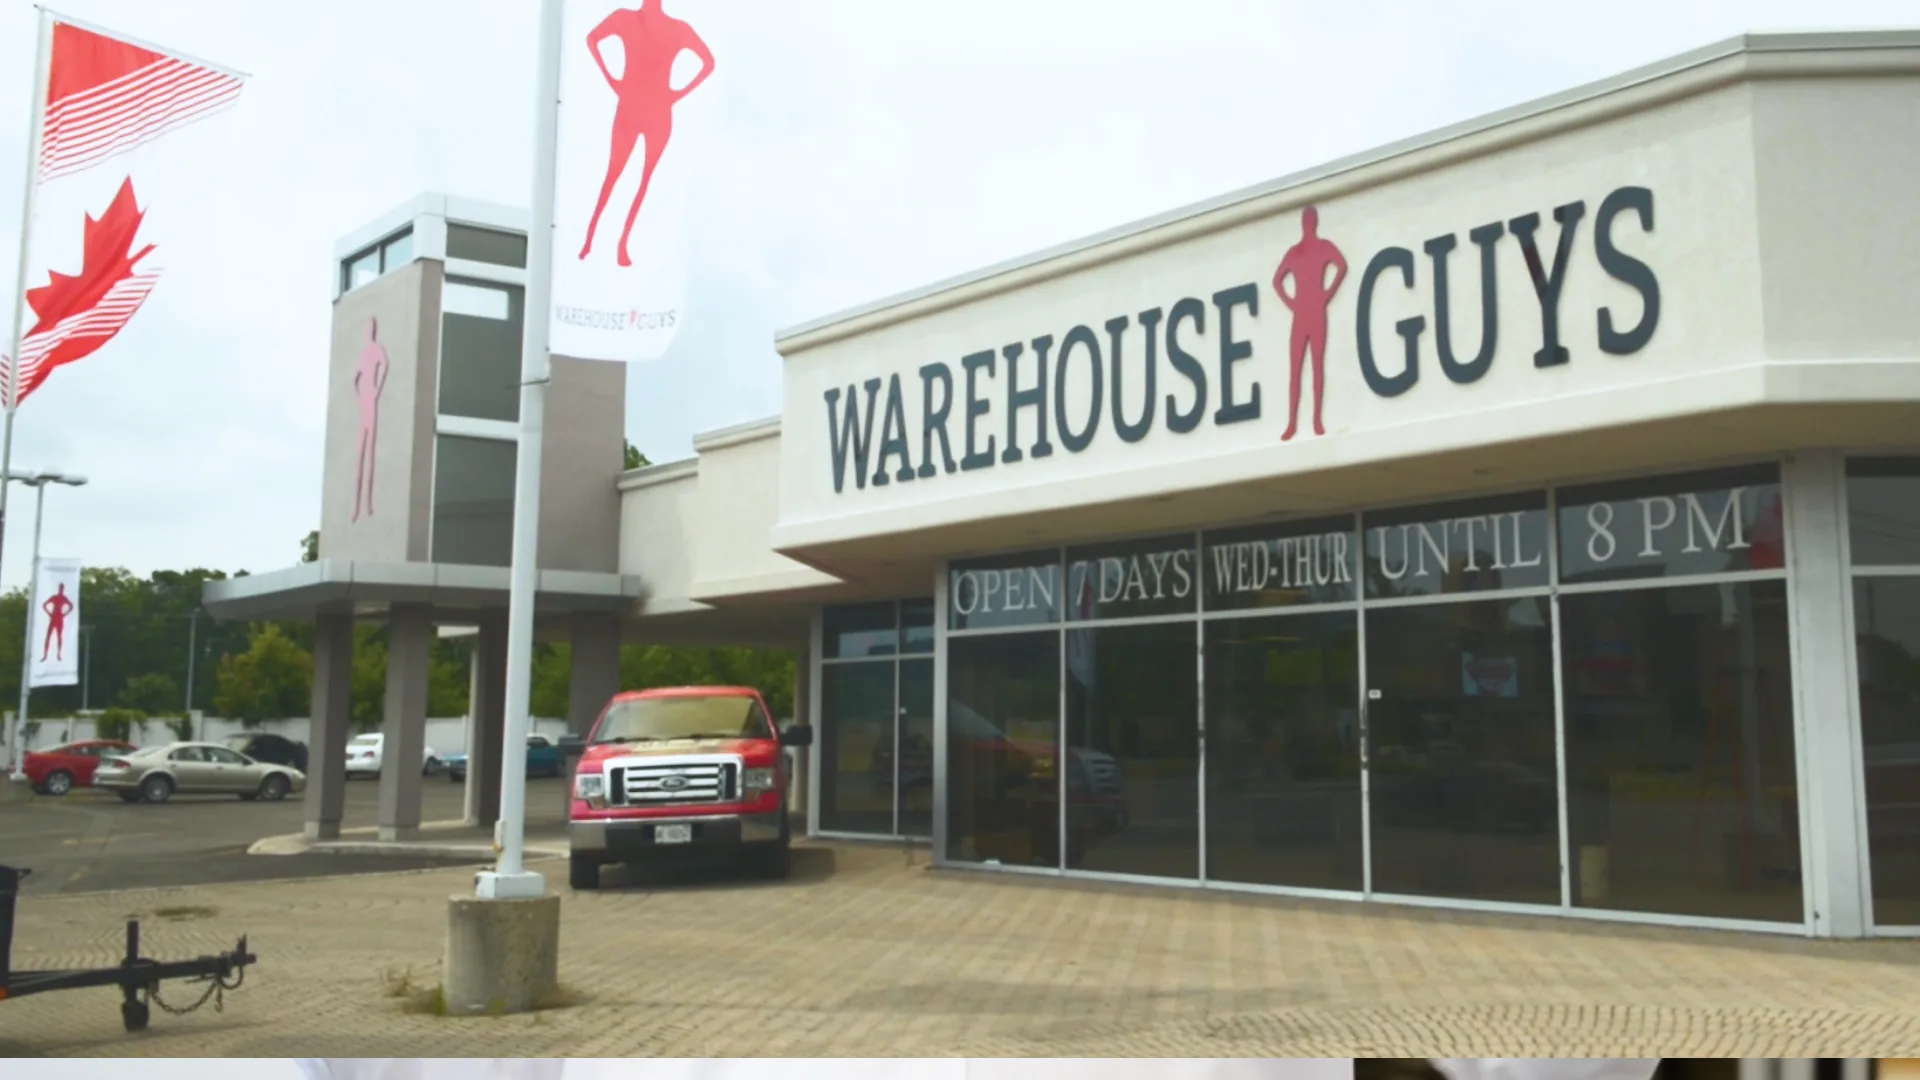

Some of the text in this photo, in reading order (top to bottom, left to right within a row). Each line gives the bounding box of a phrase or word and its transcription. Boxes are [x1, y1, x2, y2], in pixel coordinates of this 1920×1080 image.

[638, 309, 676, 331] GUYS
[824, 186, 1661, 494] WAREHOUSE GUYS
[953, 487, 1751, 615] OPEN 7 DAYS WED-THUR UNTIL 8 PM
